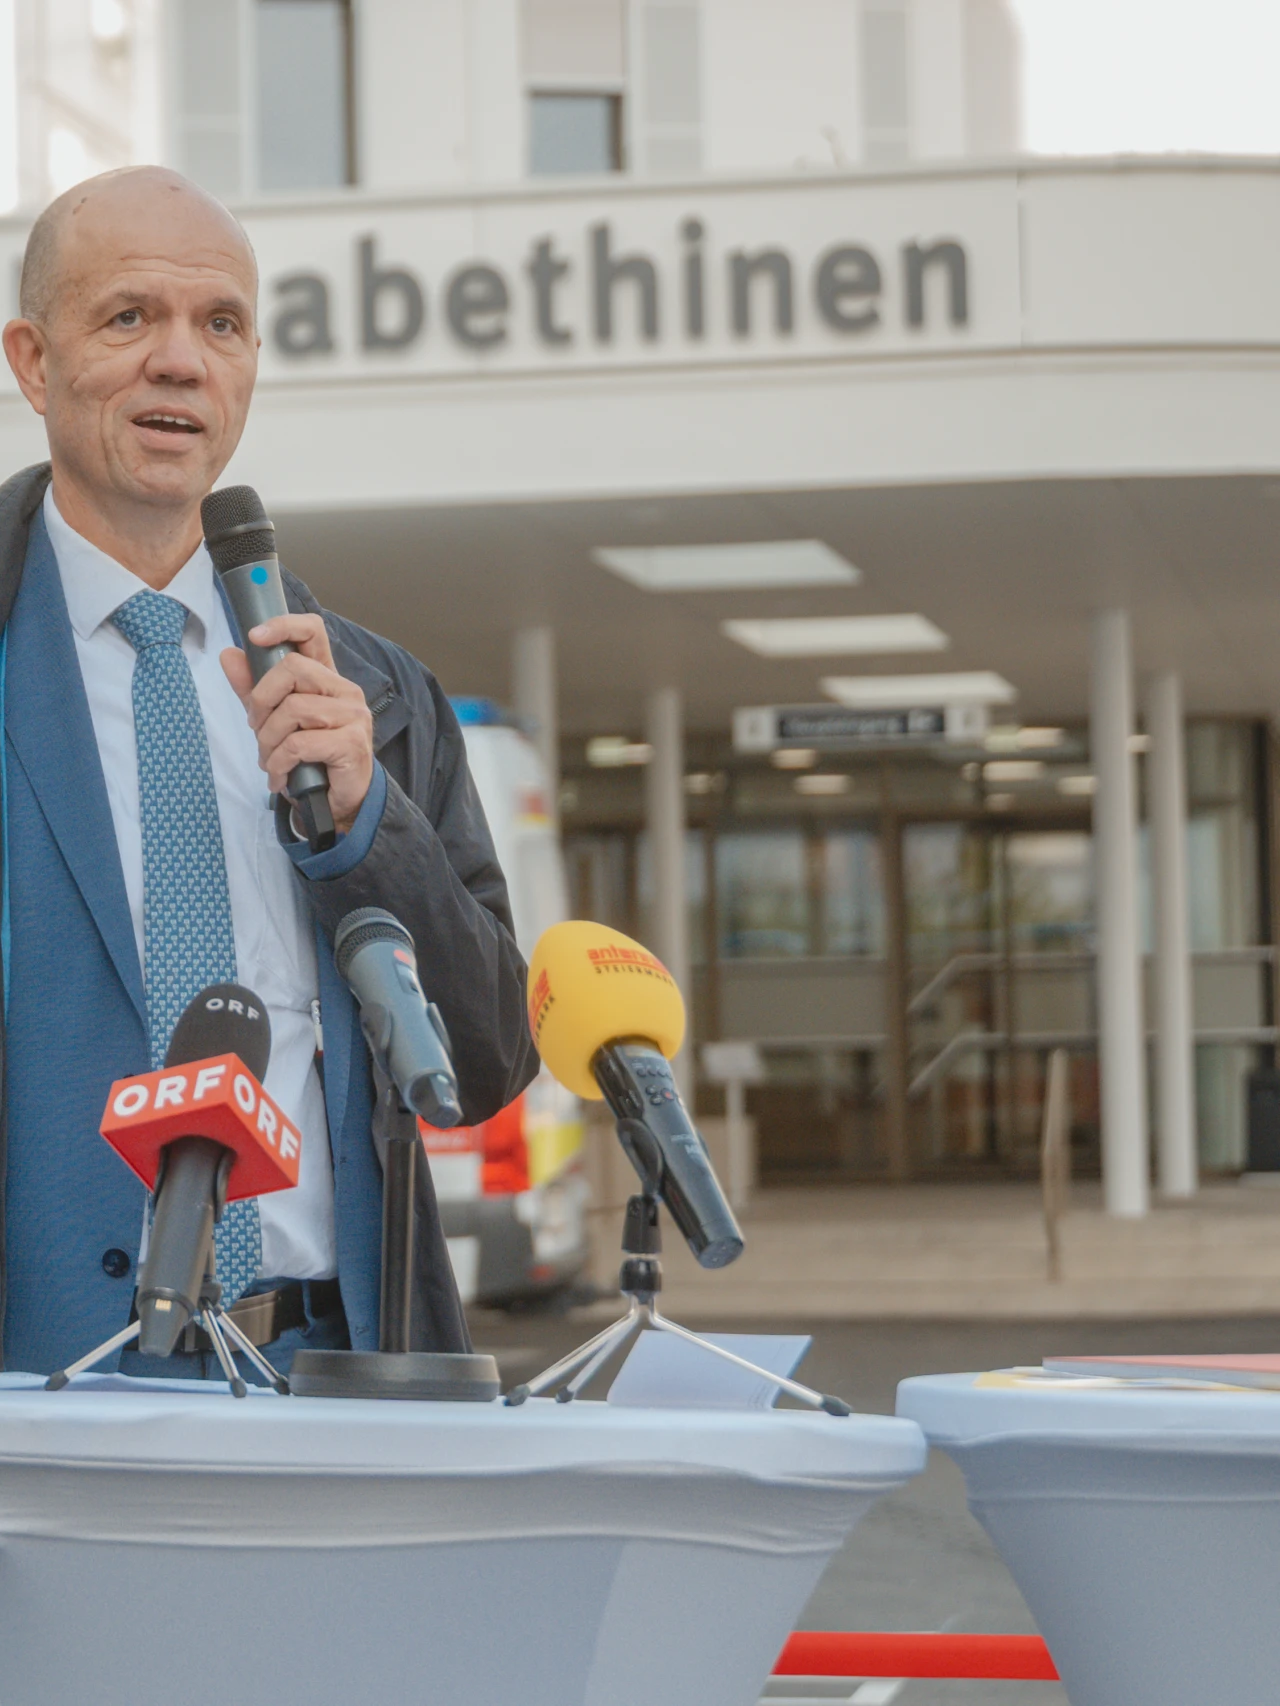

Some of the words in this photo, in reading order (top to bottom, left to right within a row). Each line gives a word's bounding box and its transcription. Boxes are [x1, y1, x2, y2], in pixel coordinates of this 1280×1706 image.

[11, 214, 972, 360] abethinen
[205, 998, 261, 1020] ORF
[113, 1064, 227, 1117] ORF
[233, 1073, 300, 1160] ORF
